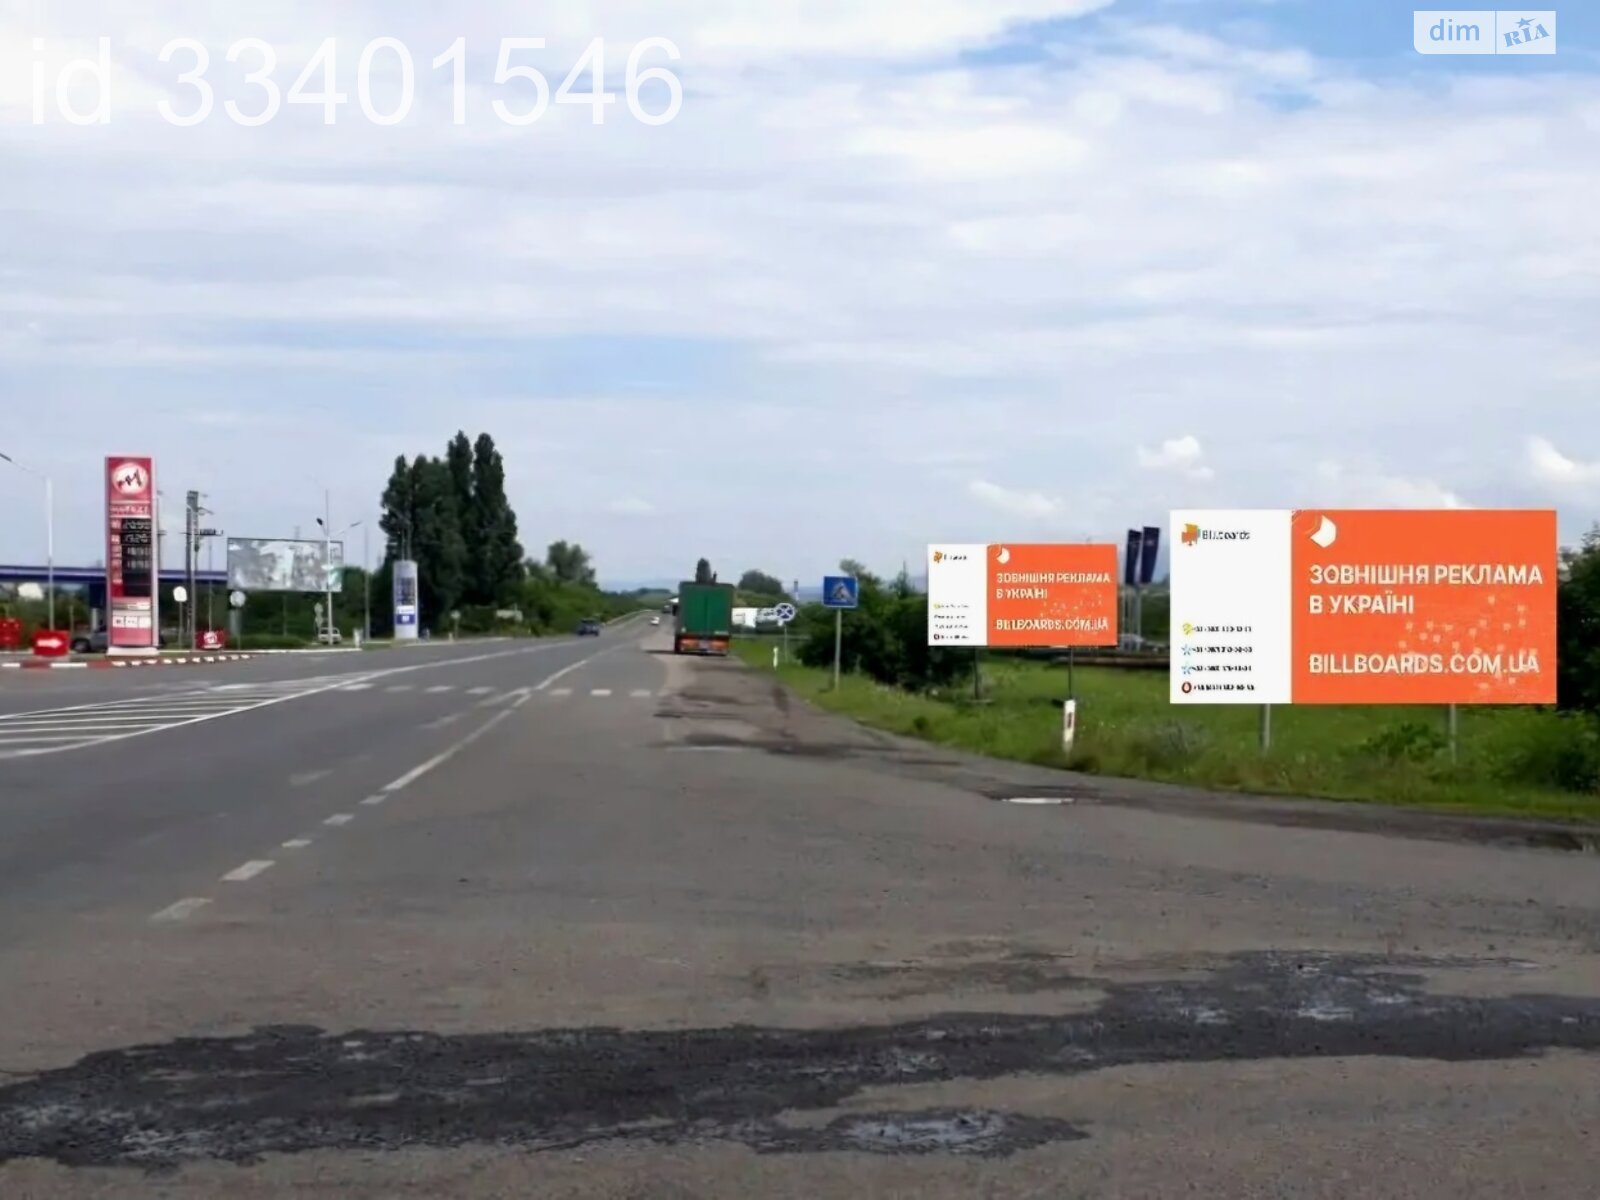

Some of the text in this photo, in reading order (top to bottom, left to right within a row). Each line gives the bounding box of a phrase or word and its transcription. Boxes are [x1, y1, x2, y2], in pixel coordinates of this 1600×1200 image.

[996, 572, 1111, 584] ЗОВНІШНЯ РЕКЛАМА
[1308, 564, 1544, 586] ЗОВНІШНЯ РЕКЛАМА
[1308, 591, 1415, 615] В УКРАЇНІ
[1308, 653, 1541, 674] BILLBOARDS.COM.UA
